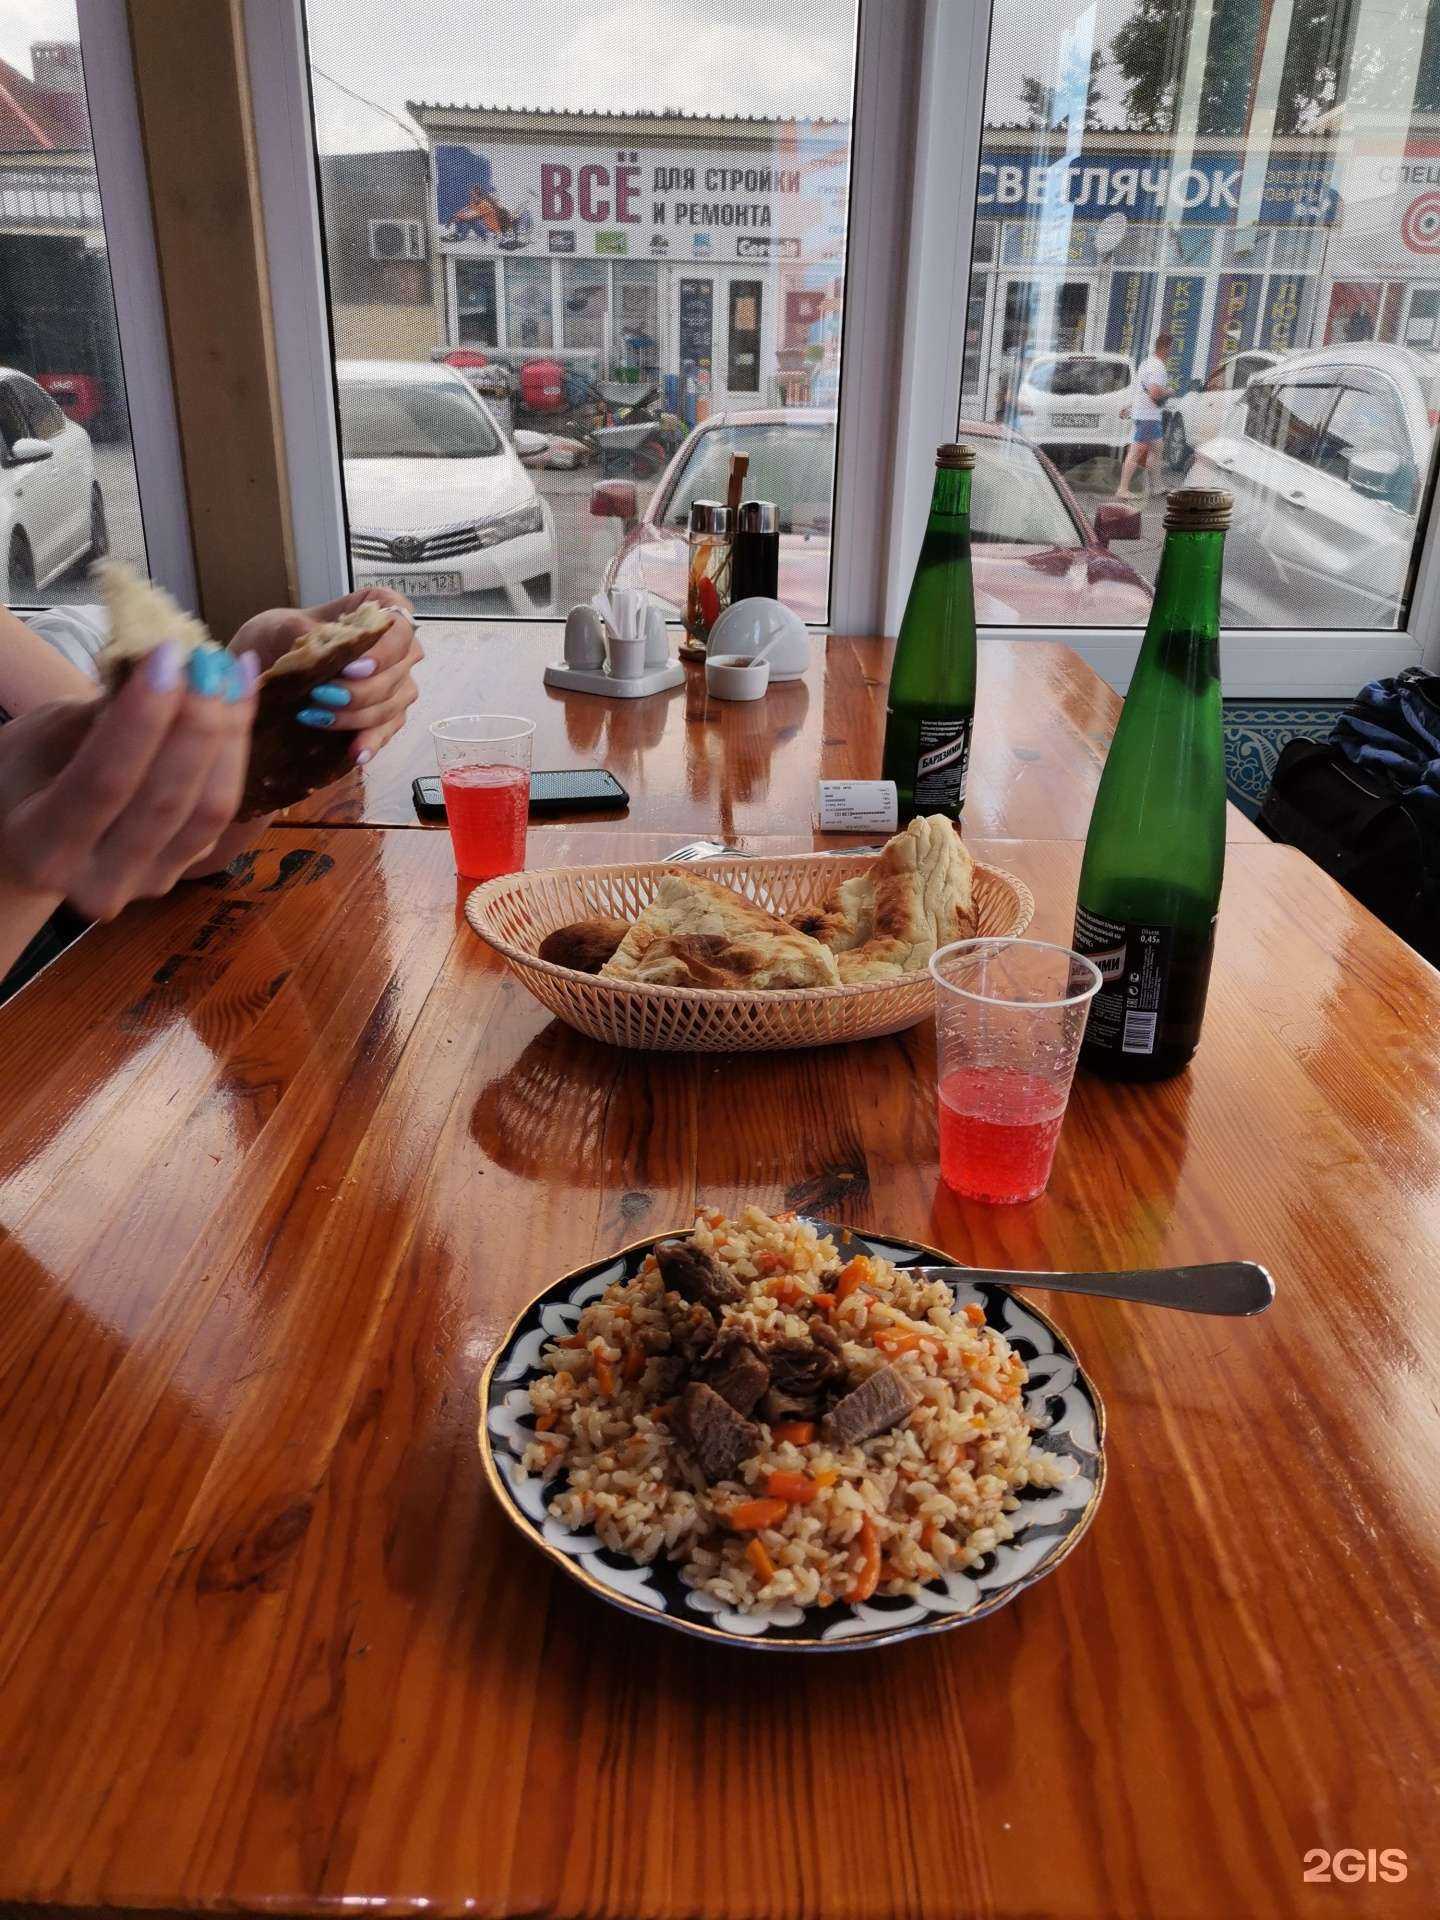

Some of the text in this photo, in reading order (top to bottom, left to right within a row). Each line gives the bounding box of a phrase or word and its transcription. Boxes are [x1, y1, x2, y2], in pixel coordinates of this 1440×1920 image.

[540, 150, 642, 224] ВСЁ
[652, 166, 800, 193] ДЛЯ СТРОЙКИ
[974, 165, 1243, 208] СВЕТЛЯЧОК
[653, 203, 772, 227] И РЕМОНТА
